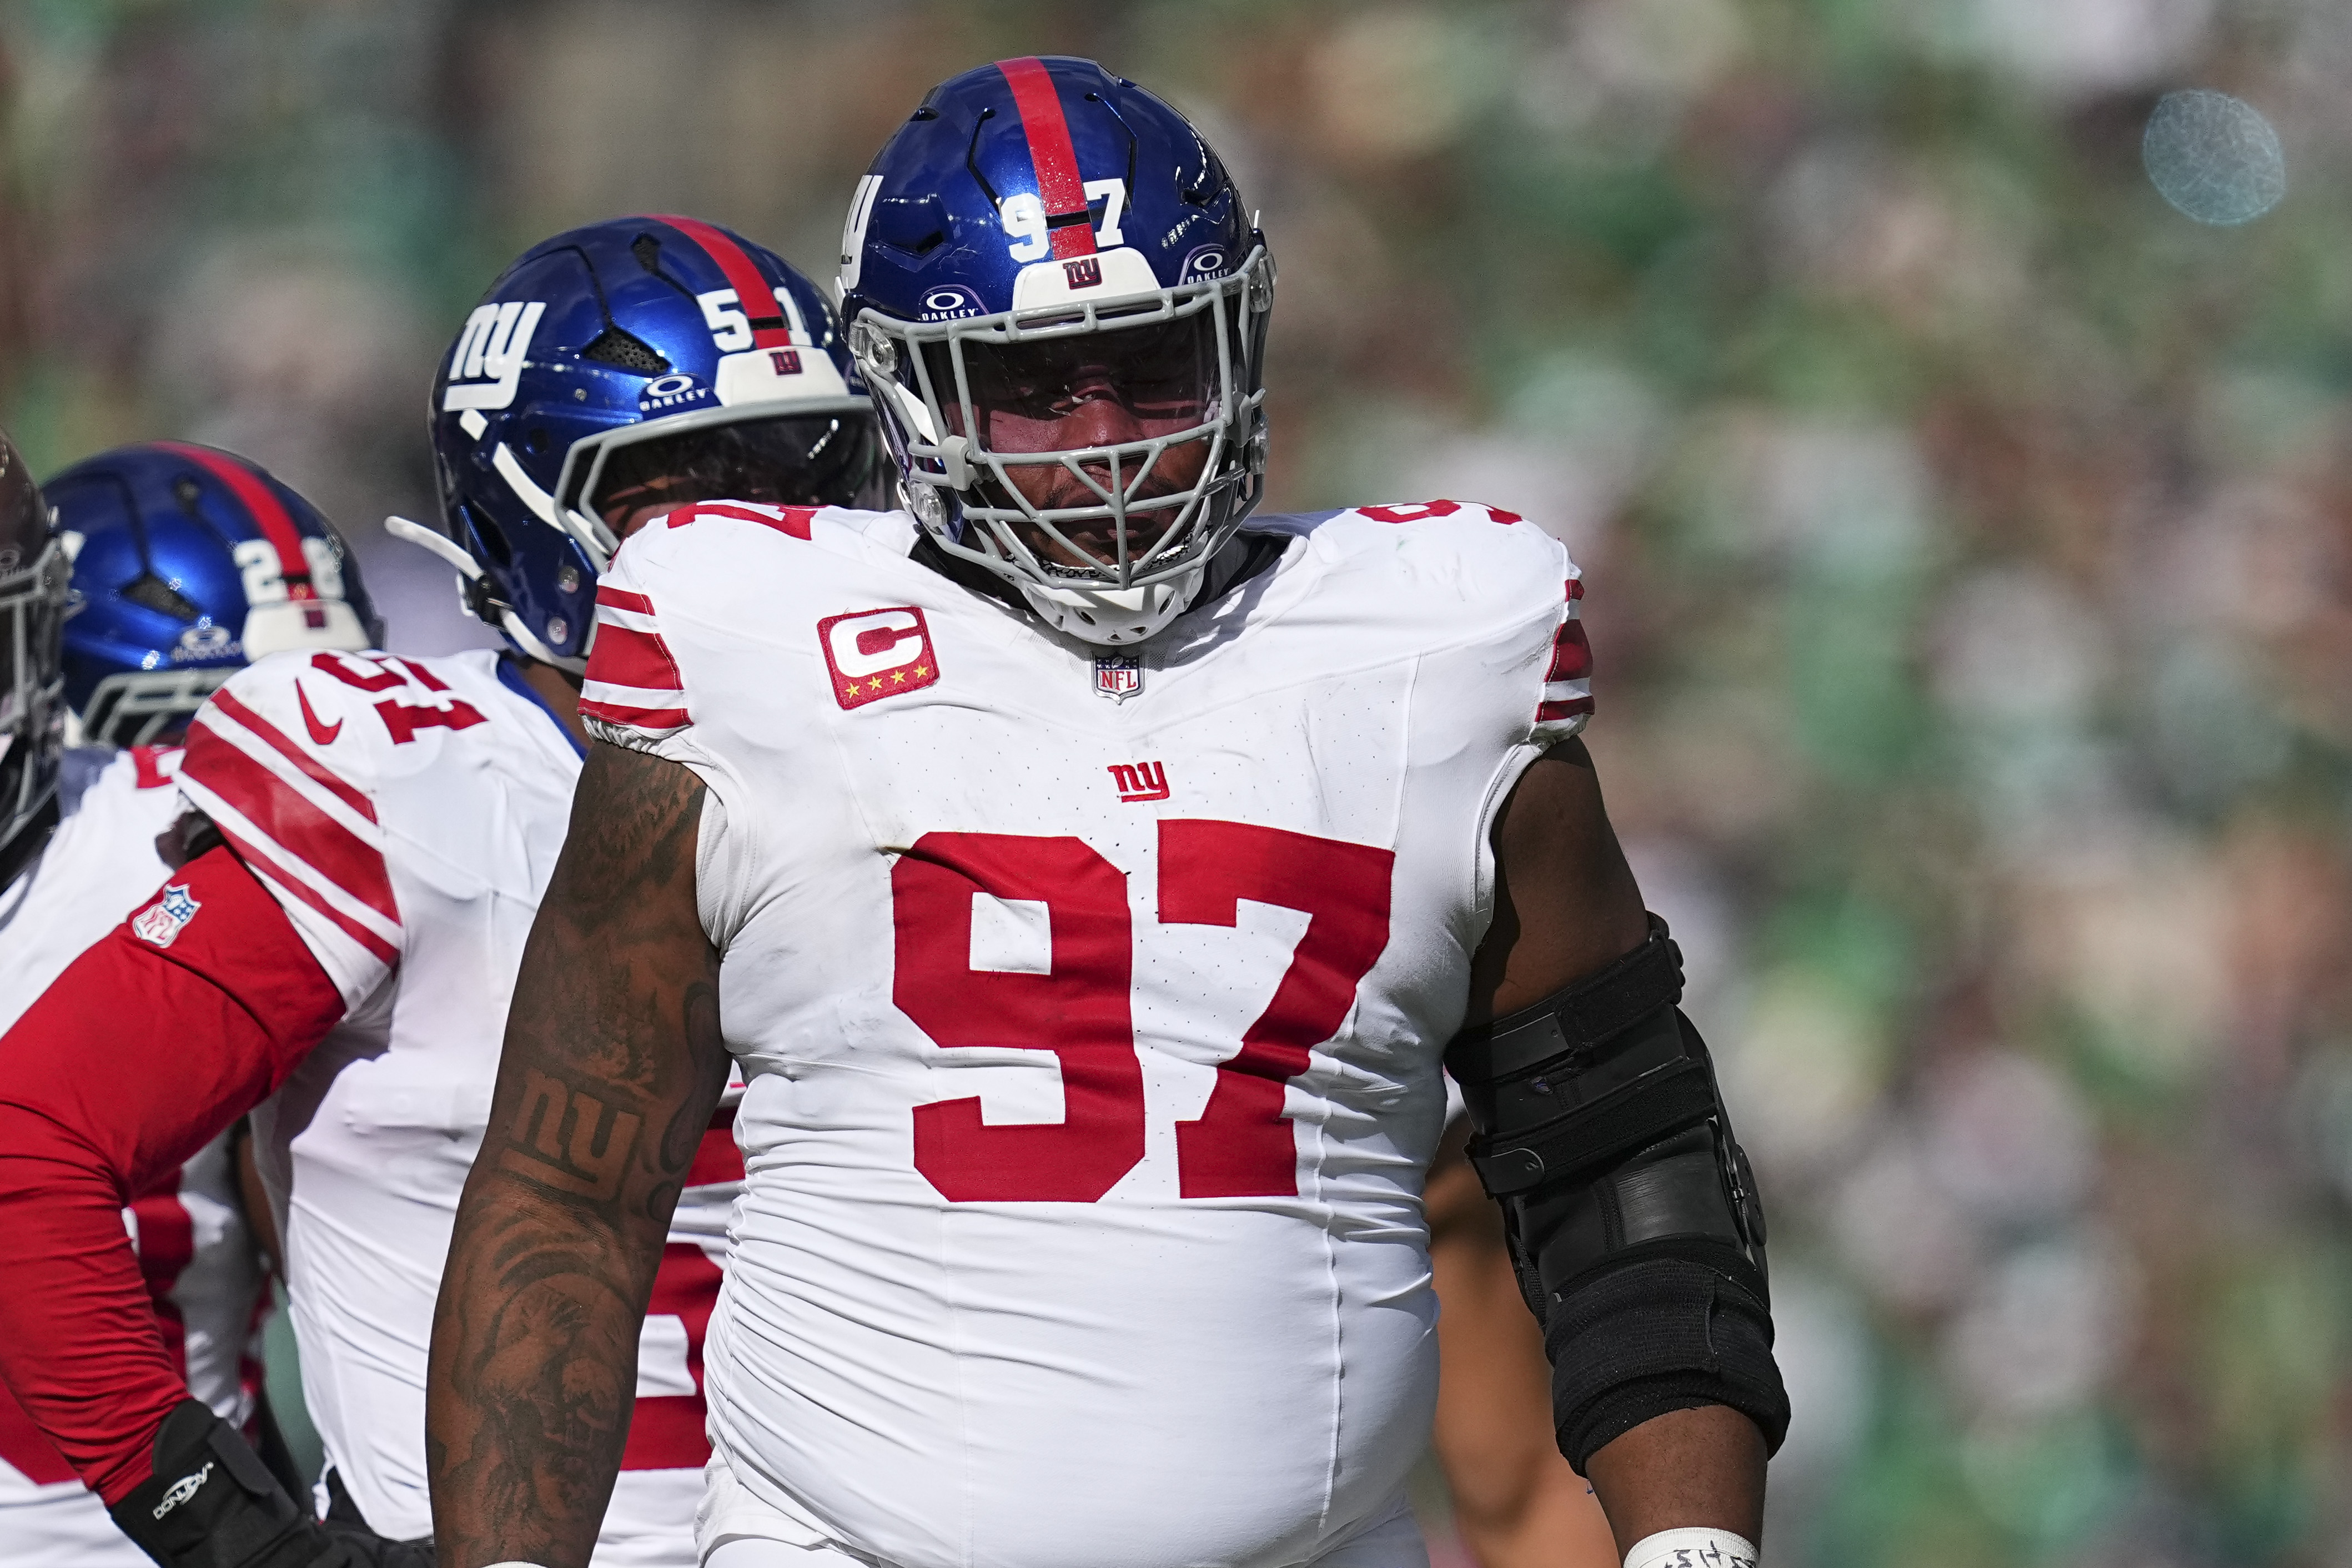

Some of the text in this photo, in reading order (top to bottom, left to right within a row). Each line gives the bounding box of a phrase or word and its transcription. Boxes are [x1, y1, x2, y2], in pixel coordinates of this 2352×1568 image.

[1001, 178, 1126, 263] 97
[1187, 268, 1229, 284] OAKLEY
[696, 287, 813, 353] 51
[921, 308, 976, 321] OAKLEY
[639, 388, 706, 411] OAKLEY
[830, 610, 923, 679] C
[1100, 670, 1137, 691] NFL
[891, 818, 1395, 1203] 97
